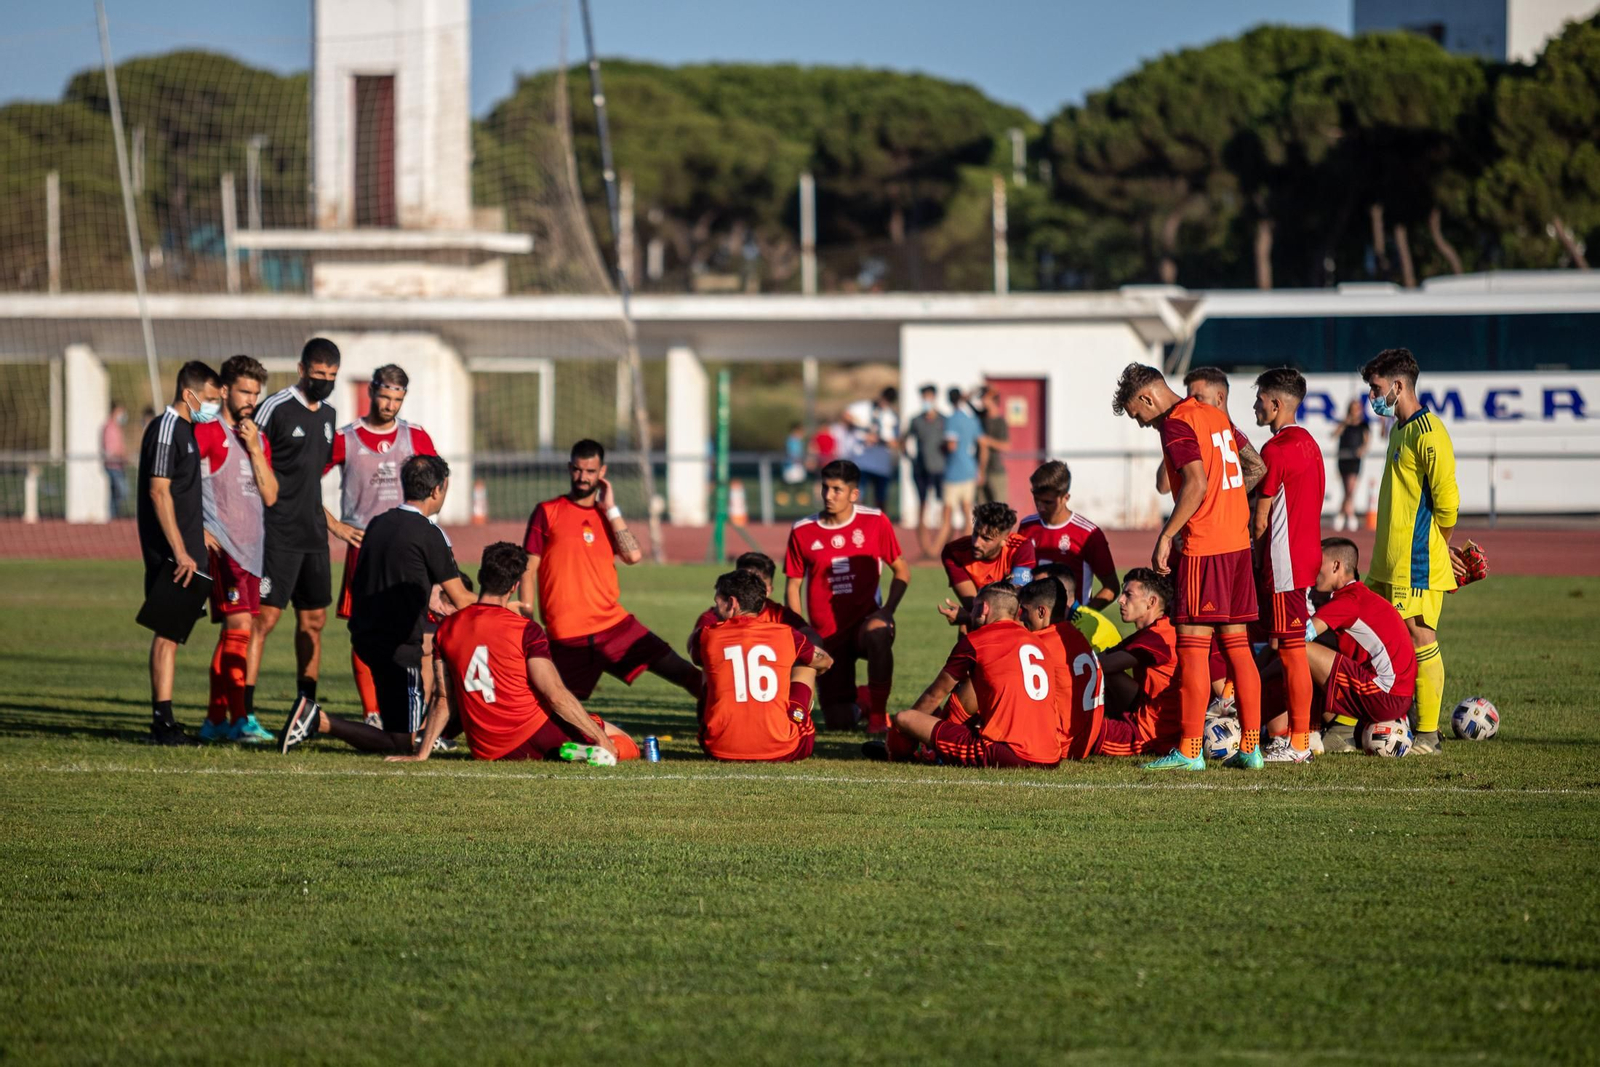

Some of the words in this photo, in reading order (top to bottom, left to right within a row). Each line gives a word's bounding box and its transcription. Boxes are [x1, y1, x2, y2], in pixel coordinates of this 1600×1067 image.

[1211, 429, 1243, 490] 15
[464, 644, 497, 704] 4
[723, 644, 779, 703] 16
[1018, 643, 1050, 702] 6
